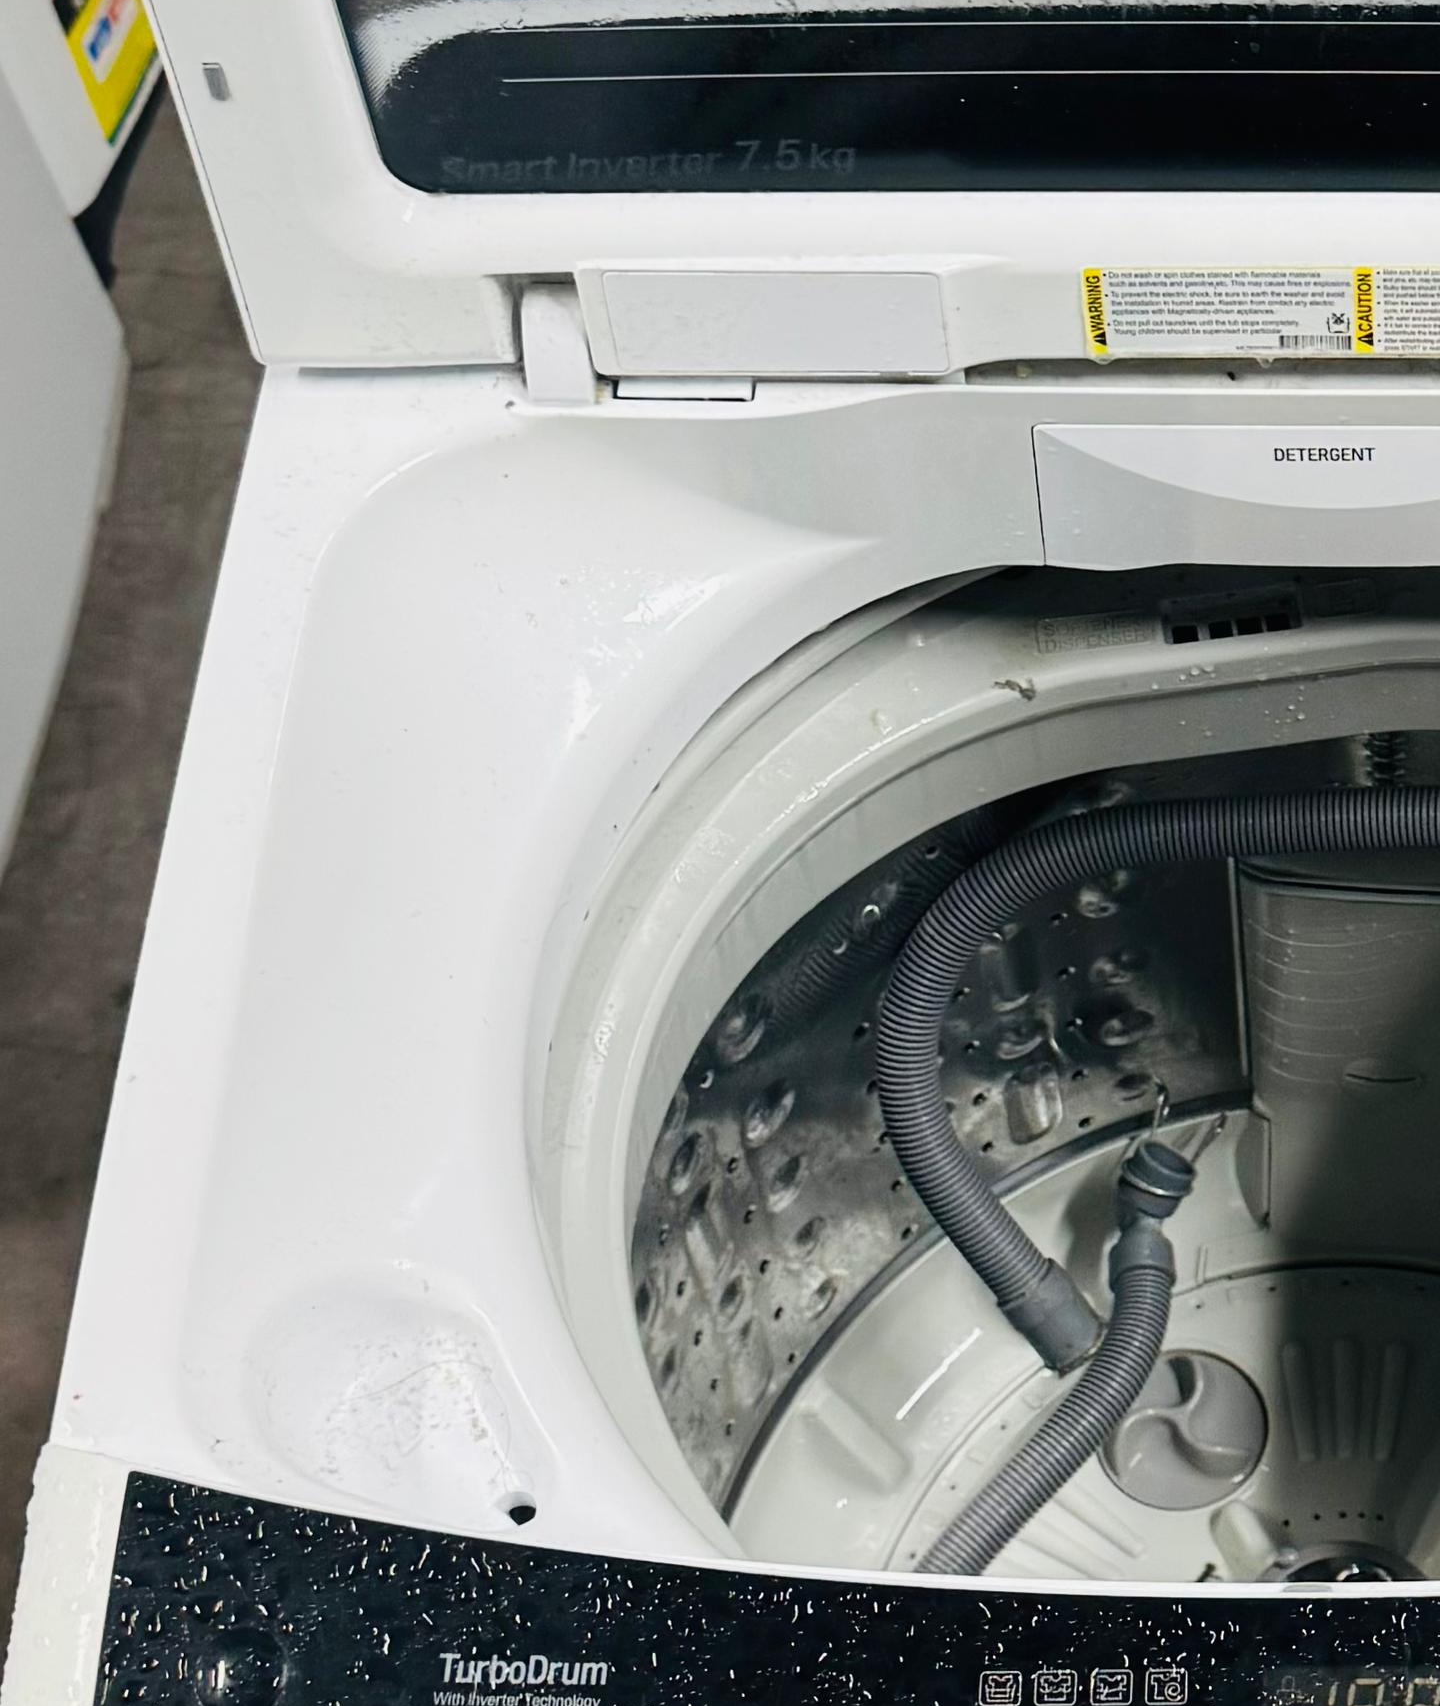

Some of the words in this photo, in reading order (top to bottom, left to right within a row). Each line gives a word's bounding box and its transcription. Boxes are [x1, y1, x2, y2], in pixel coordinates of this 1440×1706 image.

[440, 155, 557, 182] Smart
[567, 152, 722, 179] Inverter
[1086, 275, 1105, 331] WARNING
[1357, 273, 1373, 331] CAUTION
[1274, 447, 1375, 462] DETERGENT
[439, 1653, 608, 1686] TurboDrum
[433, 1690, 465, 1706] With
